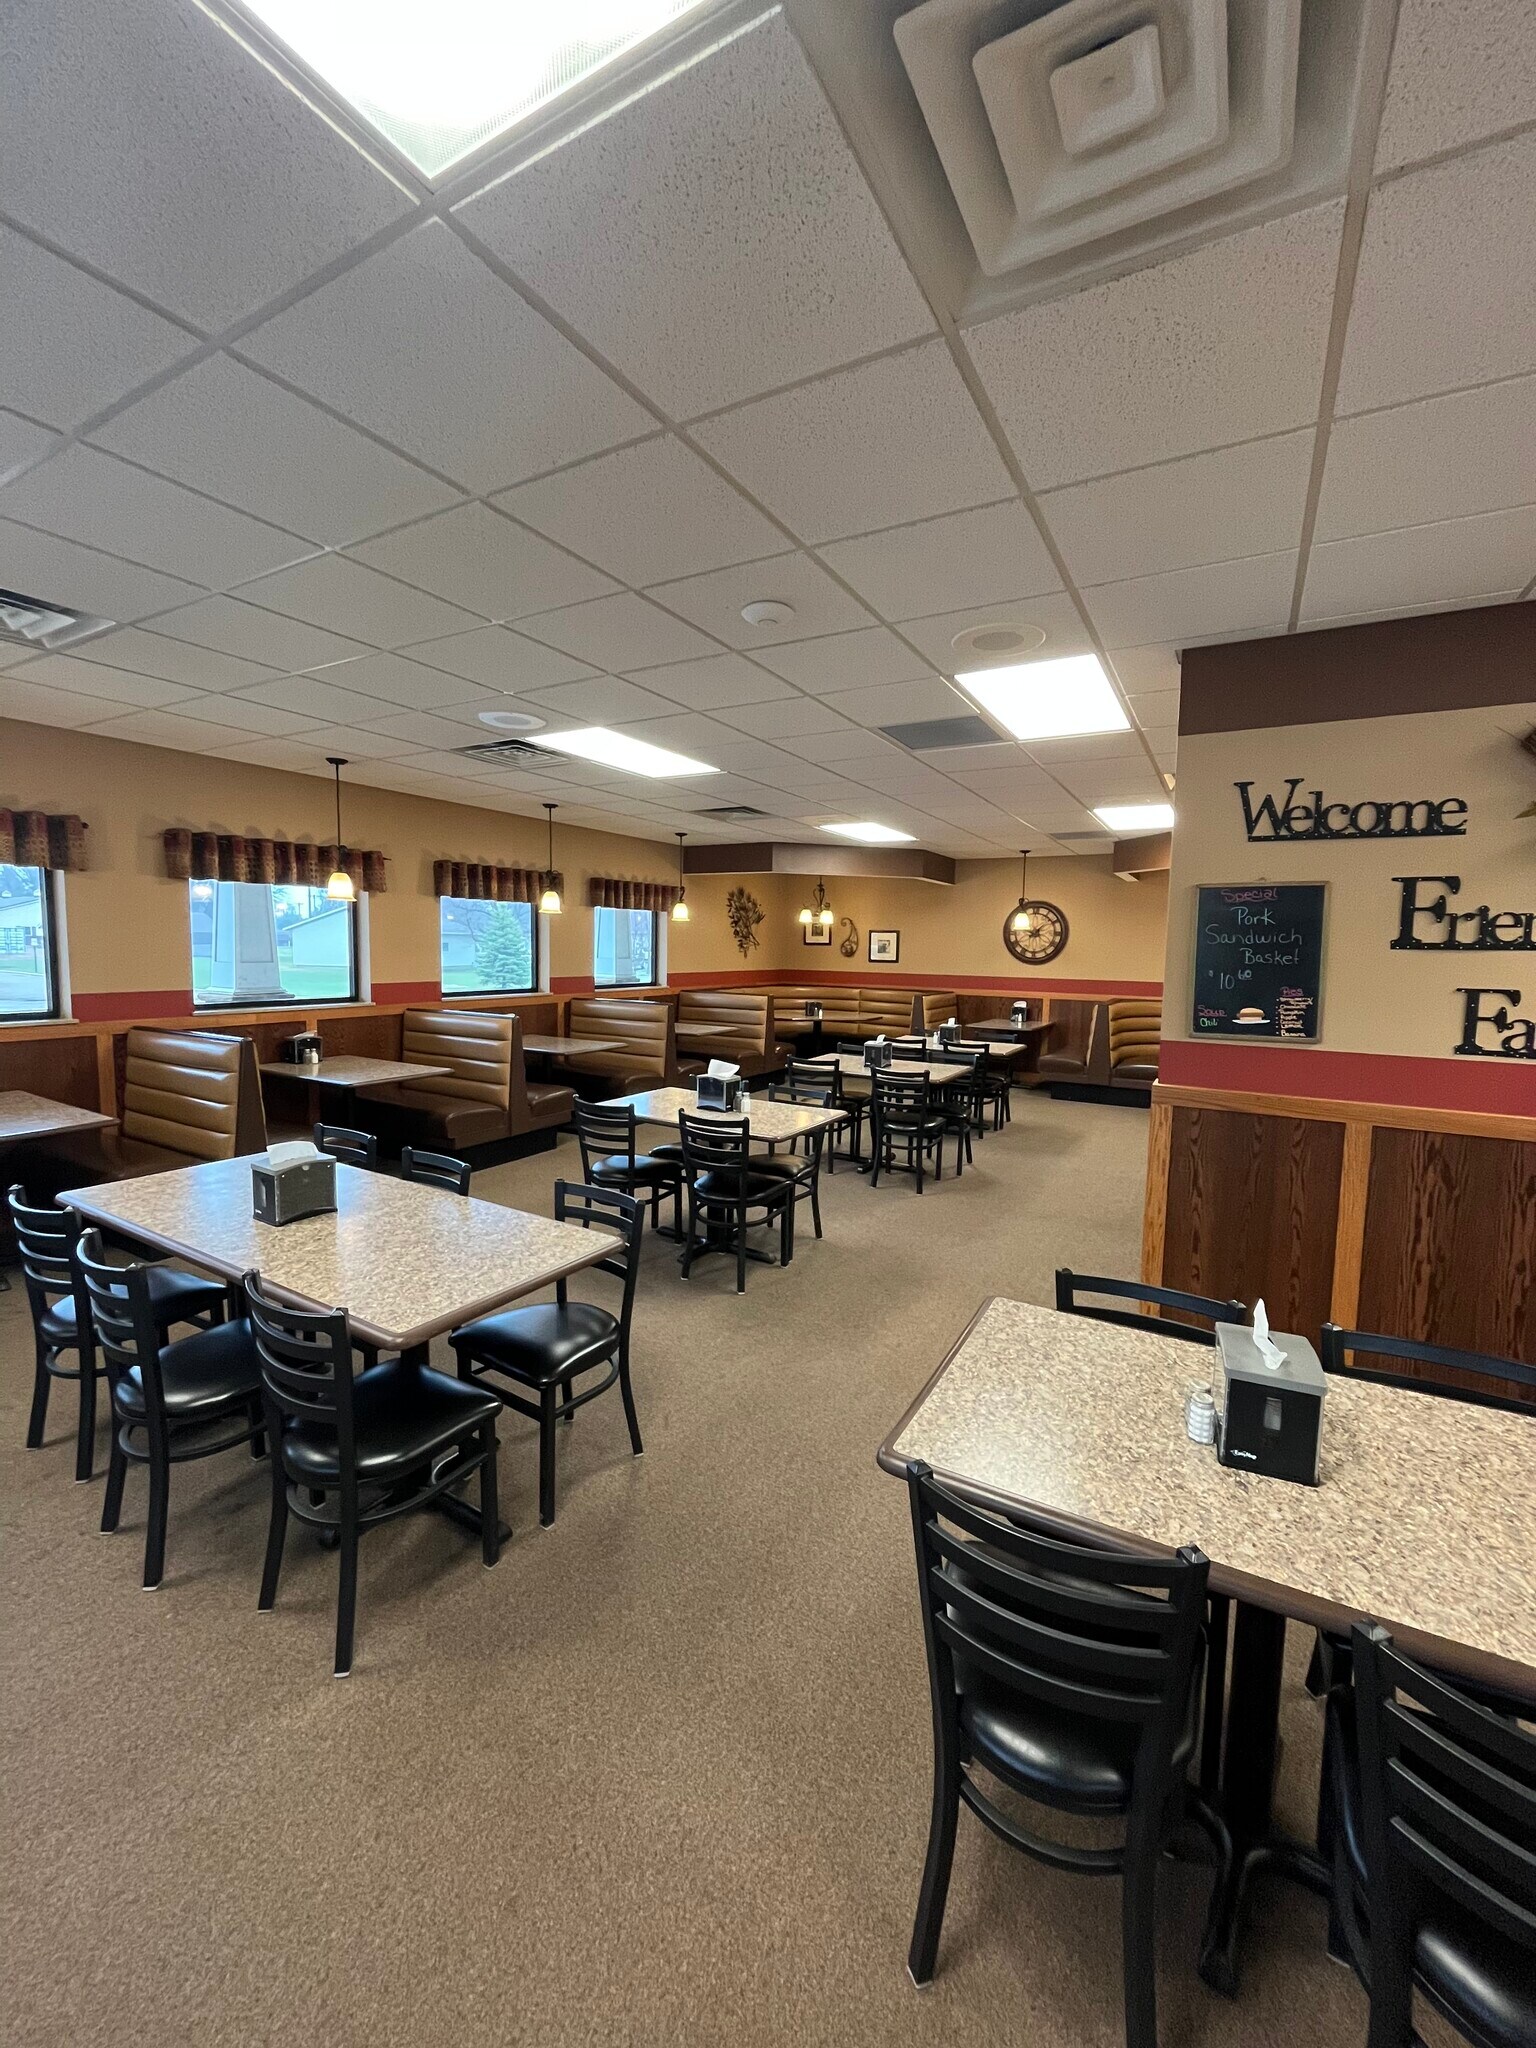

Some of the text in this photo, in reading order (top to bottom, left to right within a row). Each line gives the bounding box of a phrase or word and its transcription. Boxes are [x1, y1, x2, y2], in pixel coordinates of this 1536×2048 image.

[1233, 778, 1467, 842] Welcome
[1220, 887, 1279, 903] Special
[1230, 906, 1276, 926] Pork
[1205, 924, 1302, 946] Sandwich
[1239, 947, 1301, 965] Basket
[1199, 1017, 1219, 1027] Chili
